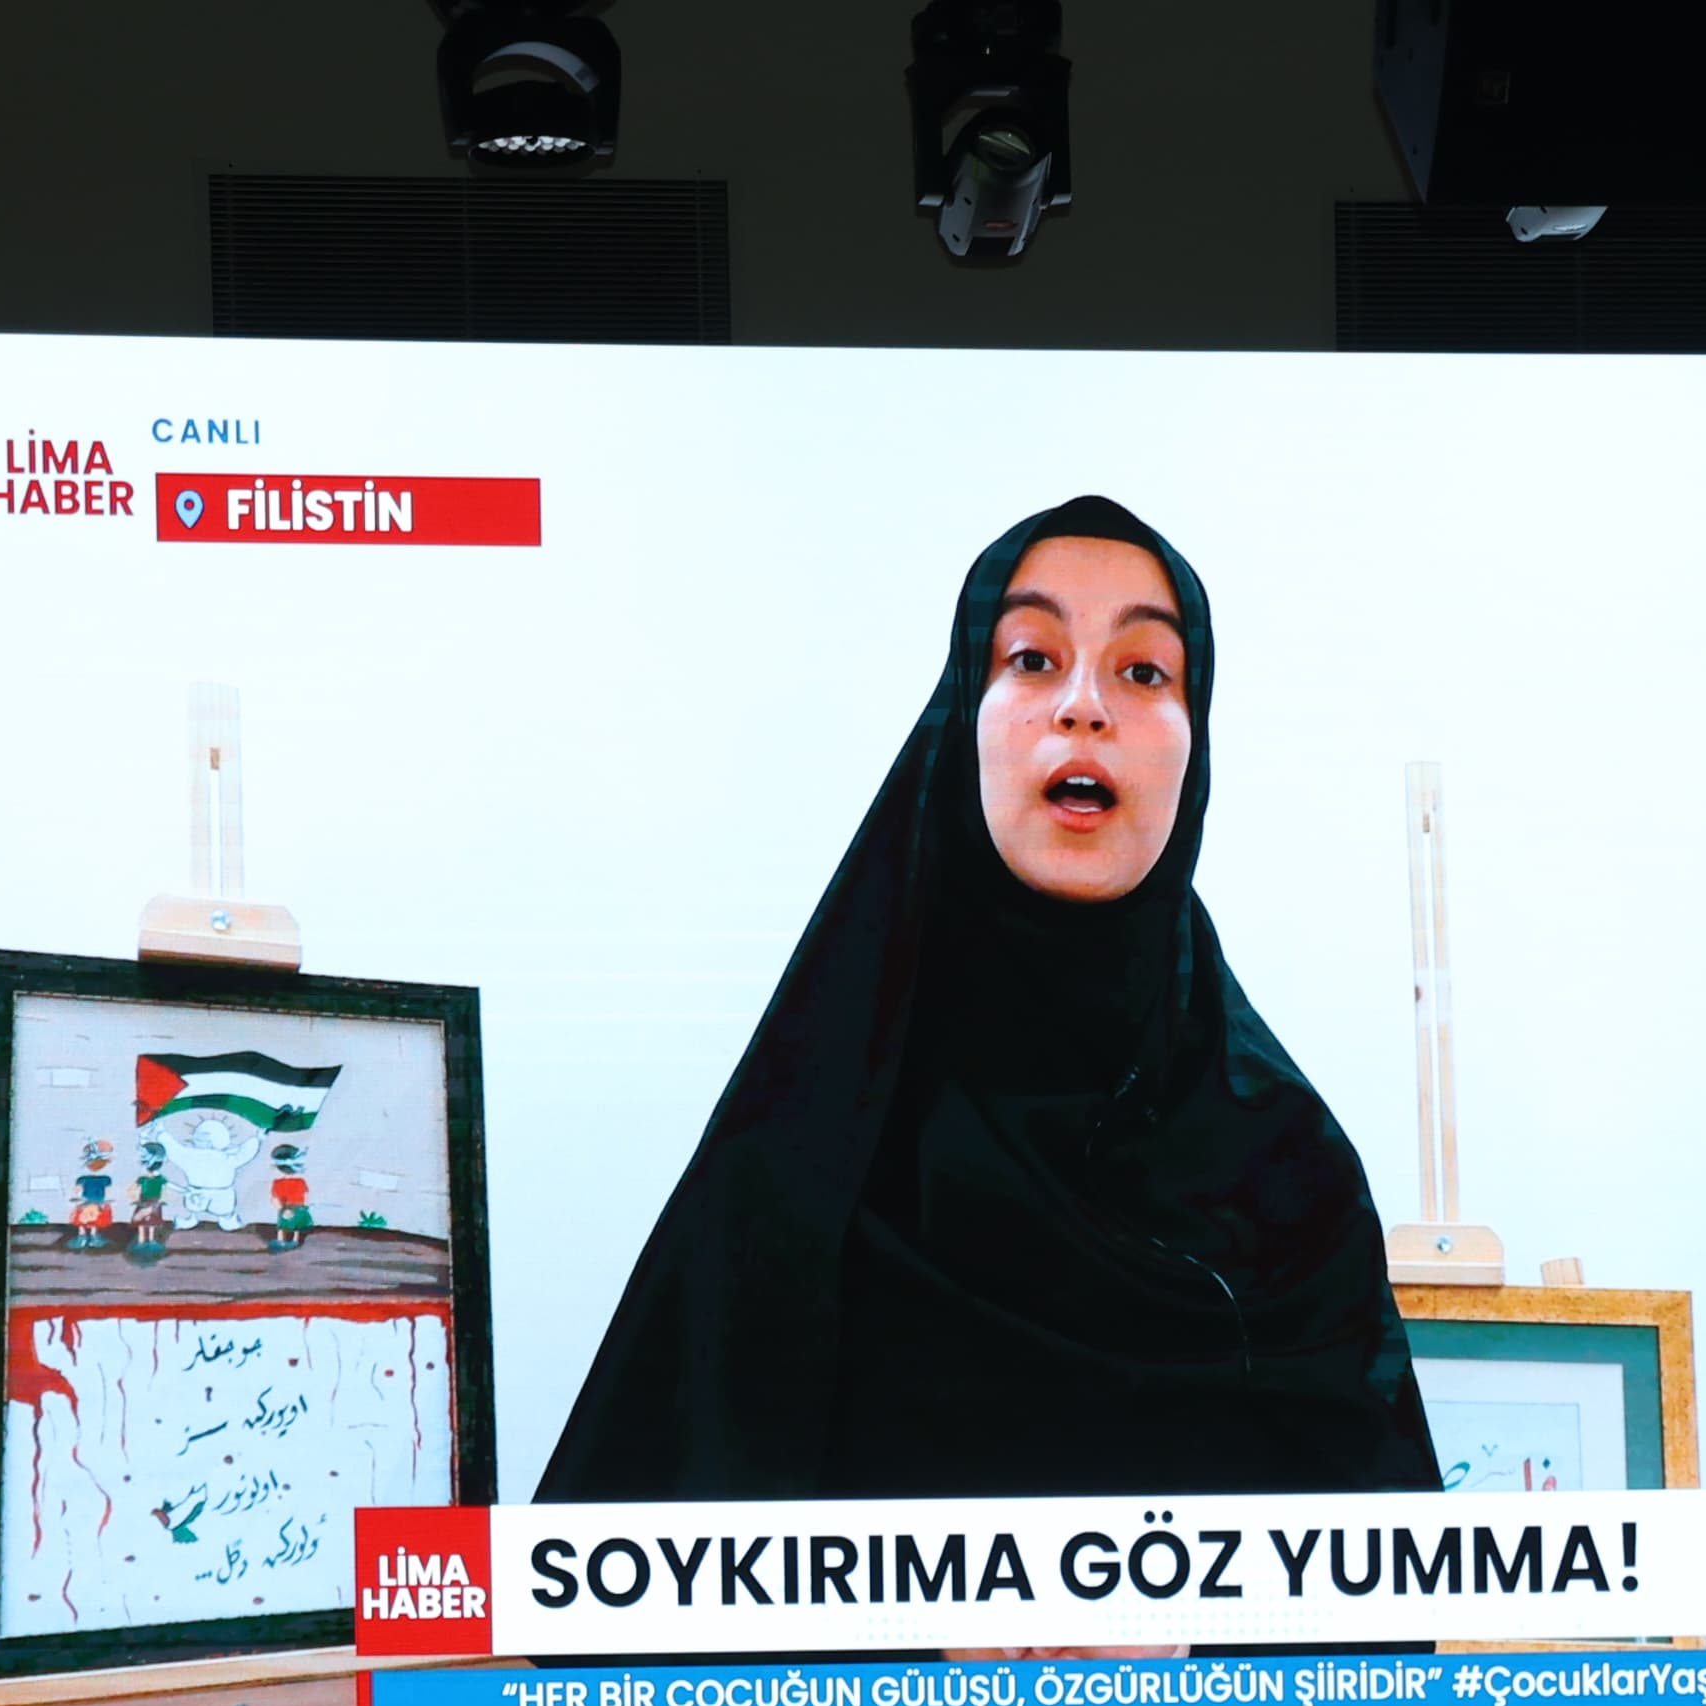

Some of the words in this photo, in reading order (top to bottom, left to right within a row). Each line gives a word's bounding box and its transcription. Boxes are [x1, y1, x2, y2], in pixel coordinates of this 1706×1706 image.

[6, 428, 114, 476] LİMA
[151, 417, 260, 445] CANLI
[227, 479, 414, 532] FİLİSTİN
[377, 1546, 470, 1588] LİMA
[530, 1533, 1035, 1609] SOYKIRIMA
[1059, 1510, 1243, 1603] GÖZ
[1268, 1522, 1639, 1598] YUMMA!
[362, 1584, 486, 1620] HABER
[1034, 1662, 1284, 1706] ÖZGÜRLÜĞÜN
